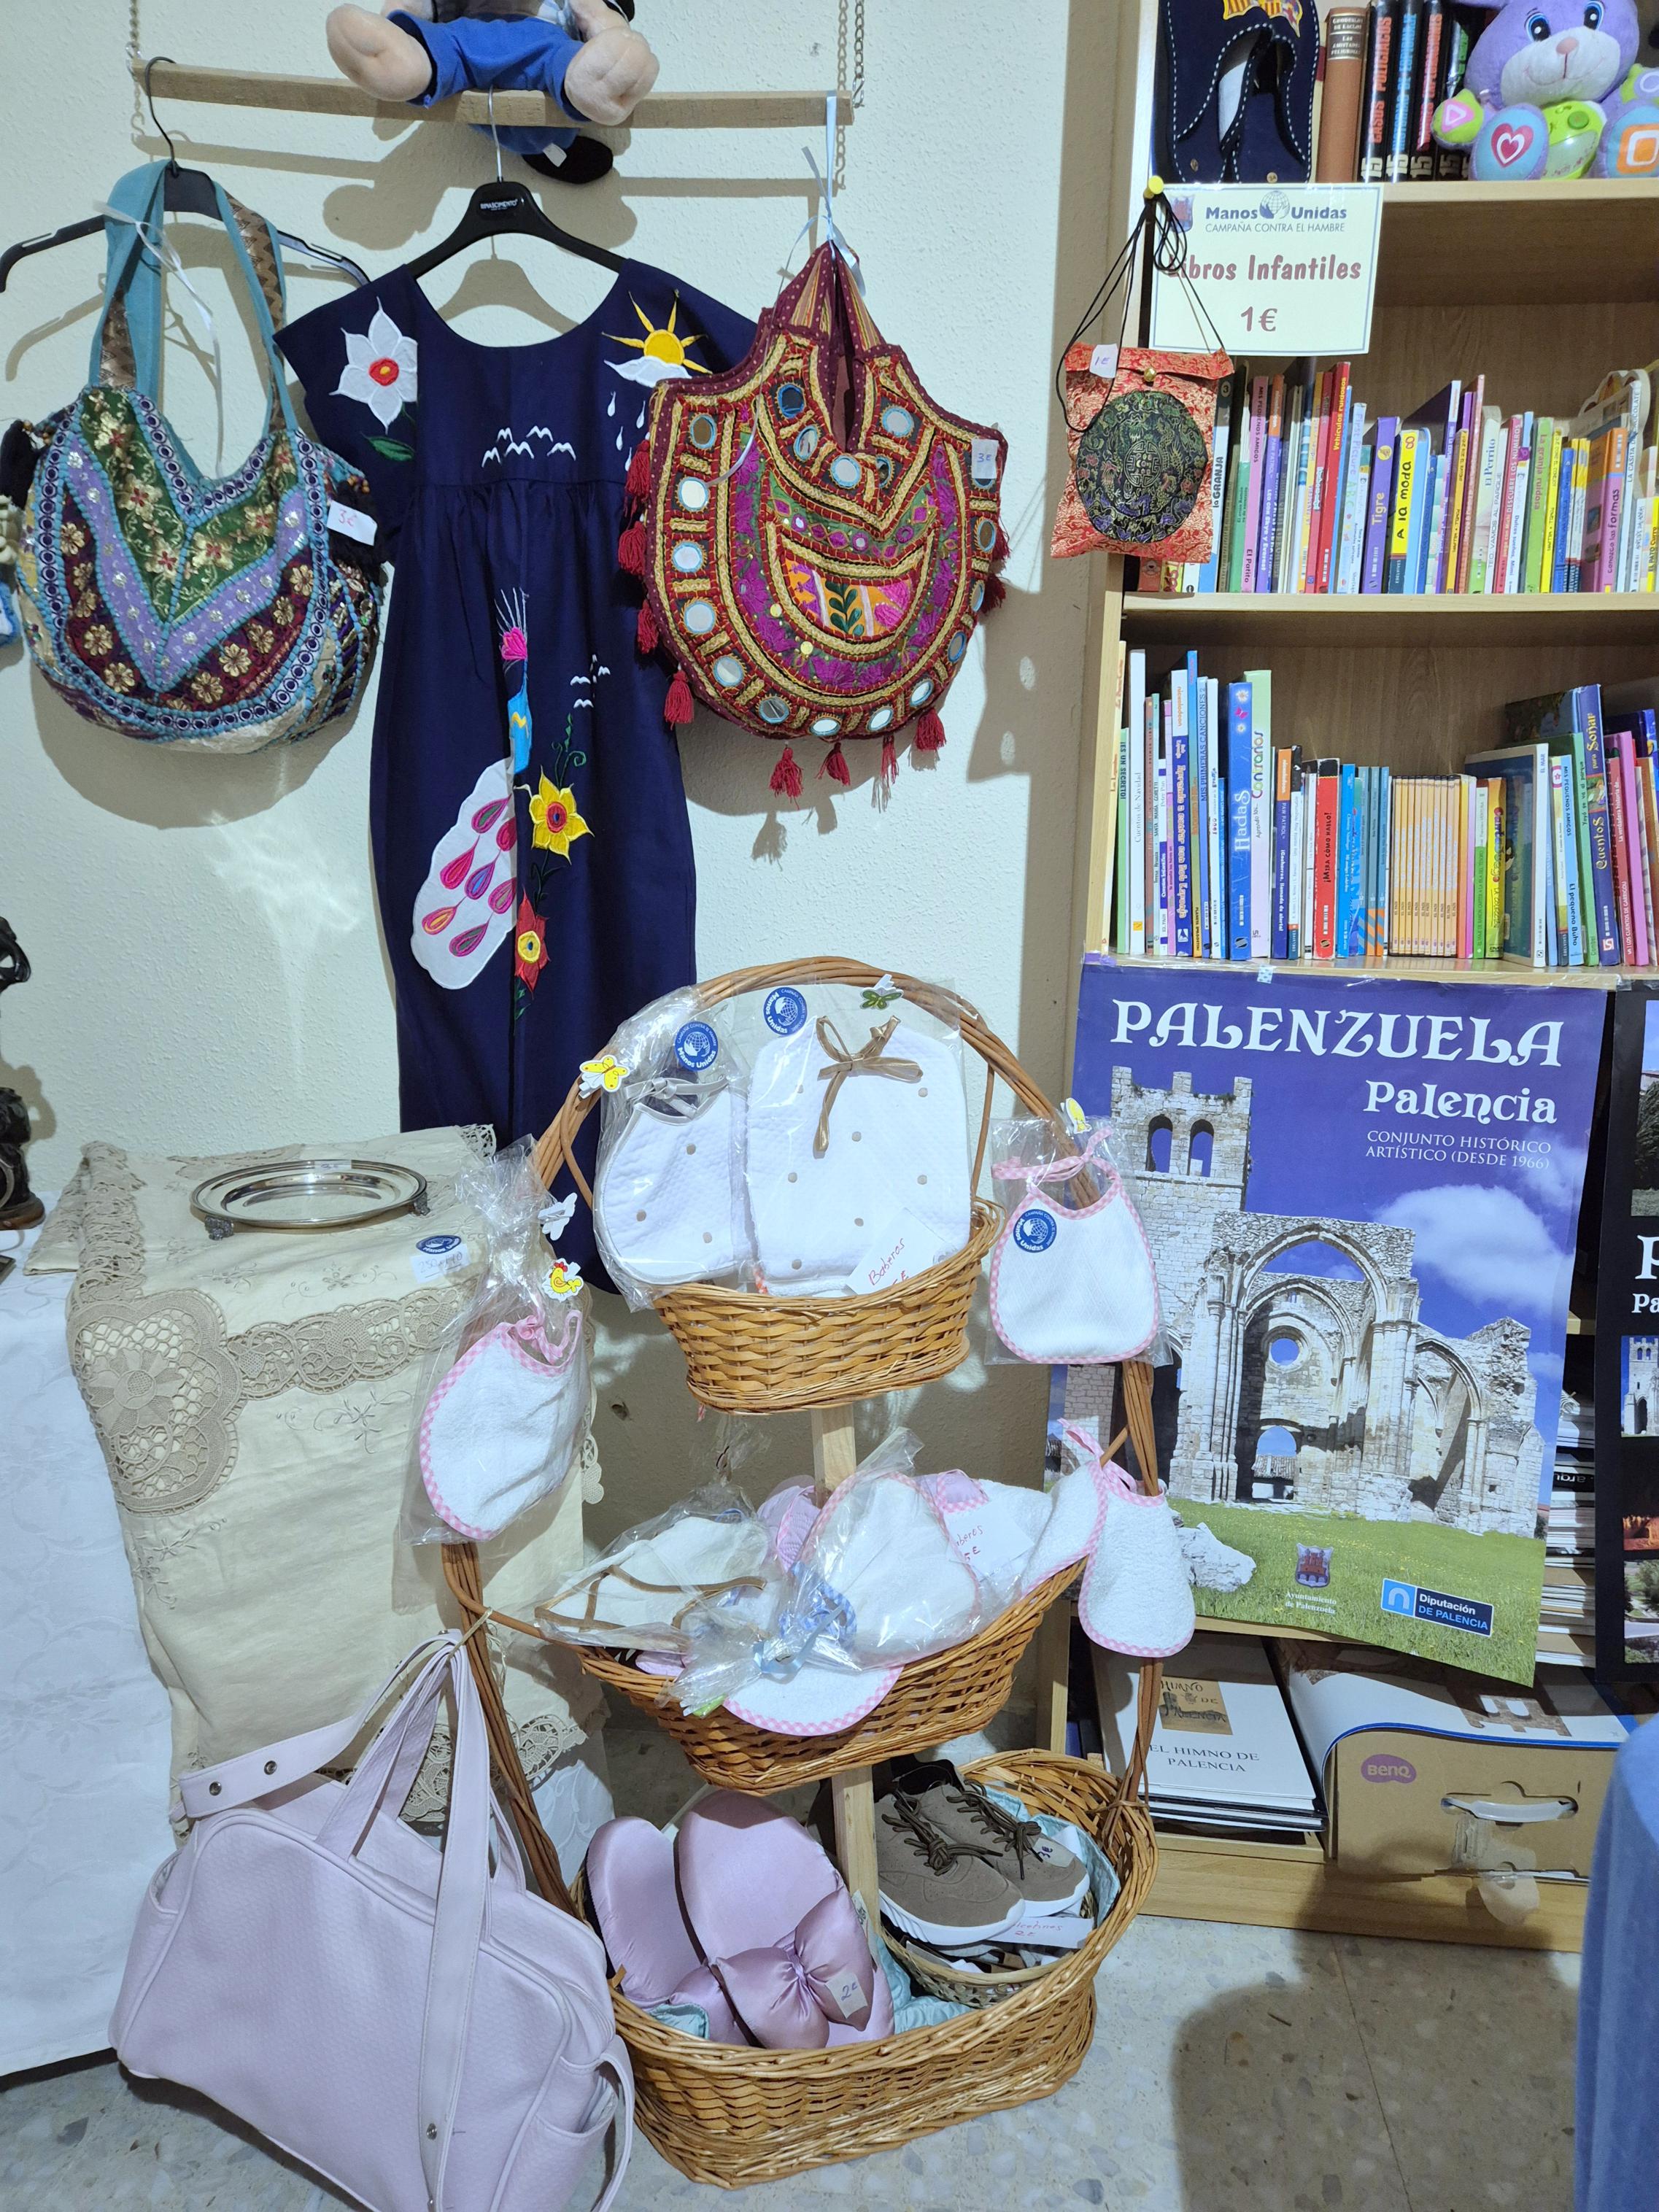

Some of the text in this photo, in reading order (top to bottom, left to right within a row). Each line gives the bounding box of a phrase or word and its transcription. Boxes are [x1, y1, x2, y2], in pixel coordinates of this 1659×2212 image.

[1368, 100, 1385, 143] CASOS
[1361, 158, 1382, 178] 15
[1387, 154, 1409, 175] 15
[1410, 156, 1432, 178] 15
[1206, 206, 1347, 219] Manos Unidas
[1205, 221, 1345, 232] CAMPAÑA CONTRA EL HAMBRE
[1248, 254, 1361, 280] Infantiles
[1240, 306, 1277, 331] 1€
[1333, 377, 1347, 450] Vehículos ruidosos
[1354, 413, 1364, 437] First
[1350, 441, 1361, 475] Picture
[1483, 438, 1496, 486] El Perrito
[1509, 462, 1517, 475] LOS
[1627, 447, 1636, 482] LA CASITA
[1213, 456, 1223, 499] GRANJA
[1534, 434, 1547, 510] La granja ruidosa
[1396, 461, 1412, 539] A la moda
[1493, 472, 1503, 504] PARQUE
[1507, 477, 1516, 512] DESCUBRE
[1372, 492, 1386, 525] Tigre
[1492, 507, 1499, 517] AL
[1608, 489, 1620, 528] formas
[1489, 520, 1498, 549] VAMOS
[1243, 549, 1253, 583] El Patito
[1606, 542, 1614, 573] conozco
[1648, 547, 1656, 562] PATO
[1509, 560, 1517, 576] Mimi
[1648, 564, 1655, 572] EL
[1199, 695, 1207, 743] CANCIONES
[1120, 755, 1126, 765] UN
[1199, 745, 1207, 787] PRIMERAS
[1591, 754, 1599, 769] para
[1177, 765, 1186, 803] Aprende
[1134, 772, 1142, 843] Cuentos de Navidad
[1177, 813, 1186, 843] contar
[1178, 846, 1187, 862] con
[1178, 865, 1188, 881] Bob
[1177, 883, 1188, 919] Esponja
[1568, 892, 1577, 925] pequeño
[1571, 927, 1579, 946] Búho
[766, 991, 788, 1035] Manos Unidas
[1110, 999, 1564, 1067] PALENZUELA
[677, 1047, 717, 1069] Manos Unidas
[1363, 1079, 1557, 1124] Palencia
[1367, 1130, 1551, 1154] CONJUNTO HISTÓRICO
[1366, 1145, 1550, 1169] ARTÍSTICO (DESDE 1966)
[1016, 1218, 1044, 1251] Manos Unidas
[1285, 1590, 1337, 1606] Ayuntamiento
[1296, 1601, 1337, 1615] Palenzuela
[1419, 1593, 1477, 1615] Diputación
[1418, 1606, 1489, 1631] DE PALENCIA
[1150, 1744, 1260, 1760] EL HIMNO DE
[1168, 1757, 1246, 1772] PALENCIA
[1368, 1765, 1411, 1778] BenQ
